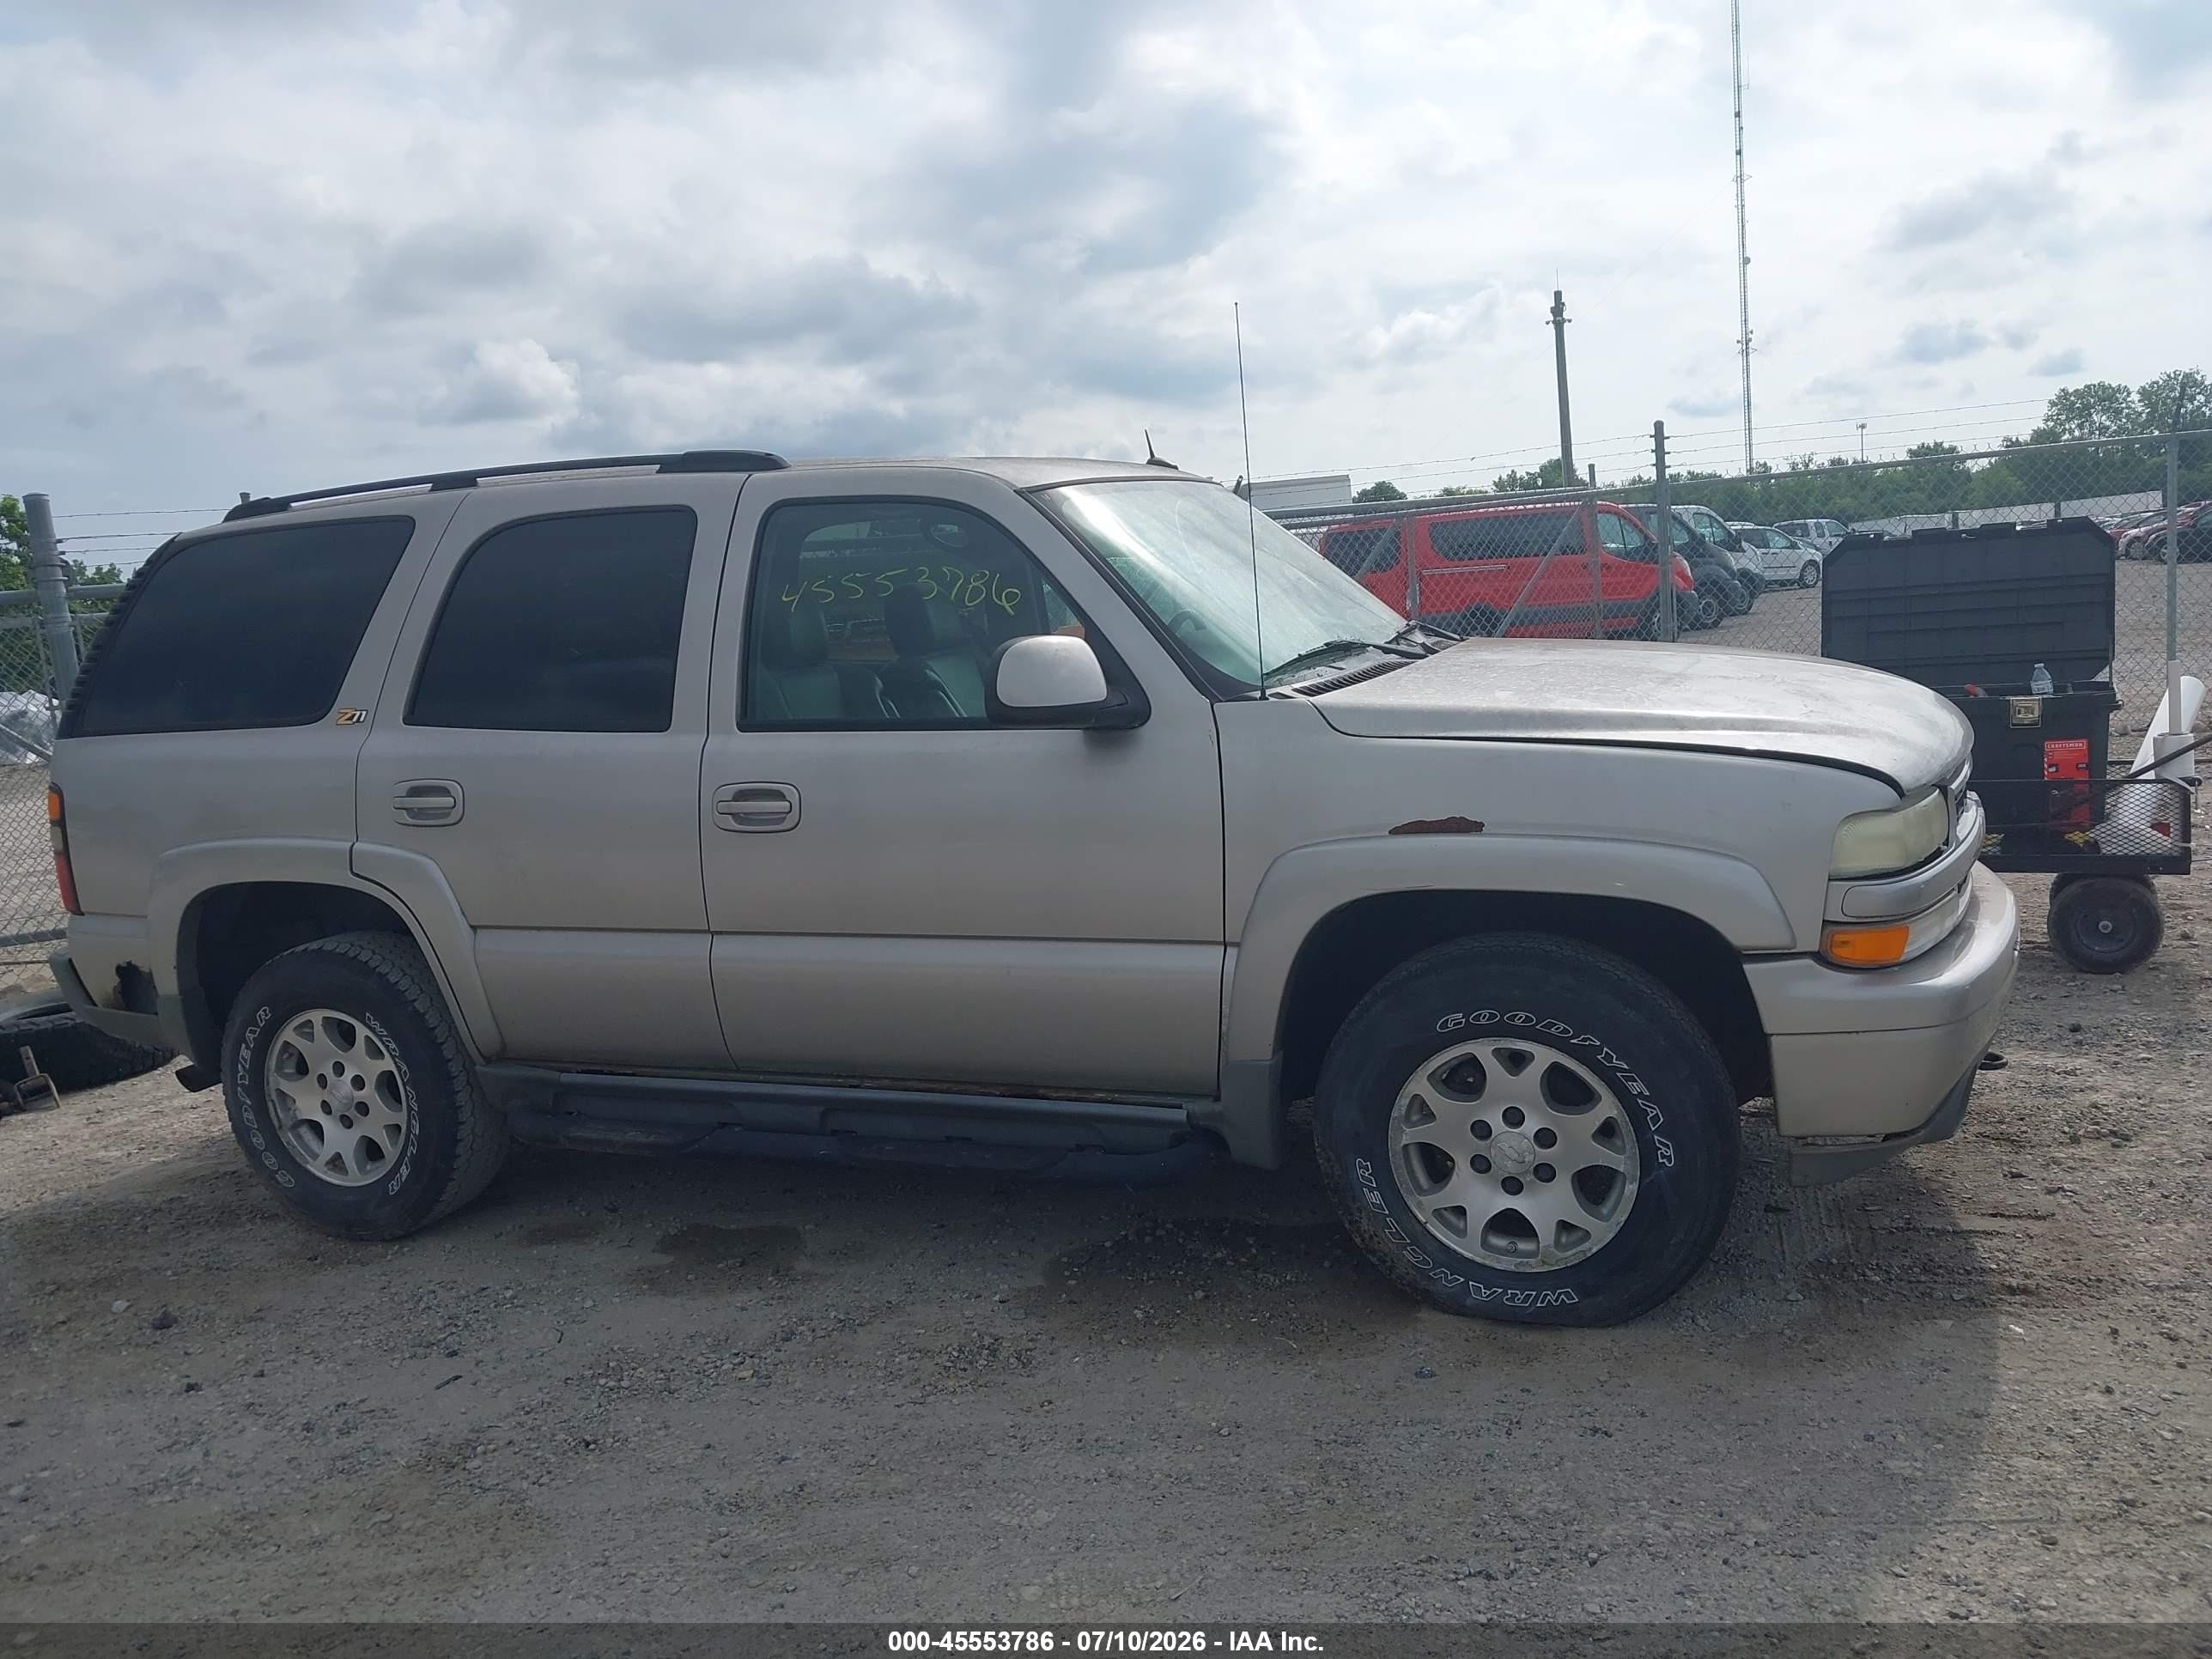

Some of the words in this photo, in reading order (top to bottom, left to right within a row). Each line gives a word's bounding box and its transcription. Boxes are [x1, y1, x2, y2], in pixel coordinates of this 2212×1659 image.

[781, 566, 1021, 617] 45553786
[336, 708, 368, 726] Z71
[236, 1006, 295, 1188] GOODYEAR
[365, 1012, 420, 1195] WRANGLER
[1437, 1010, 1674, 1168] GOODYEAR
[1356, 1158, 1579, 1307] WRANGLER
